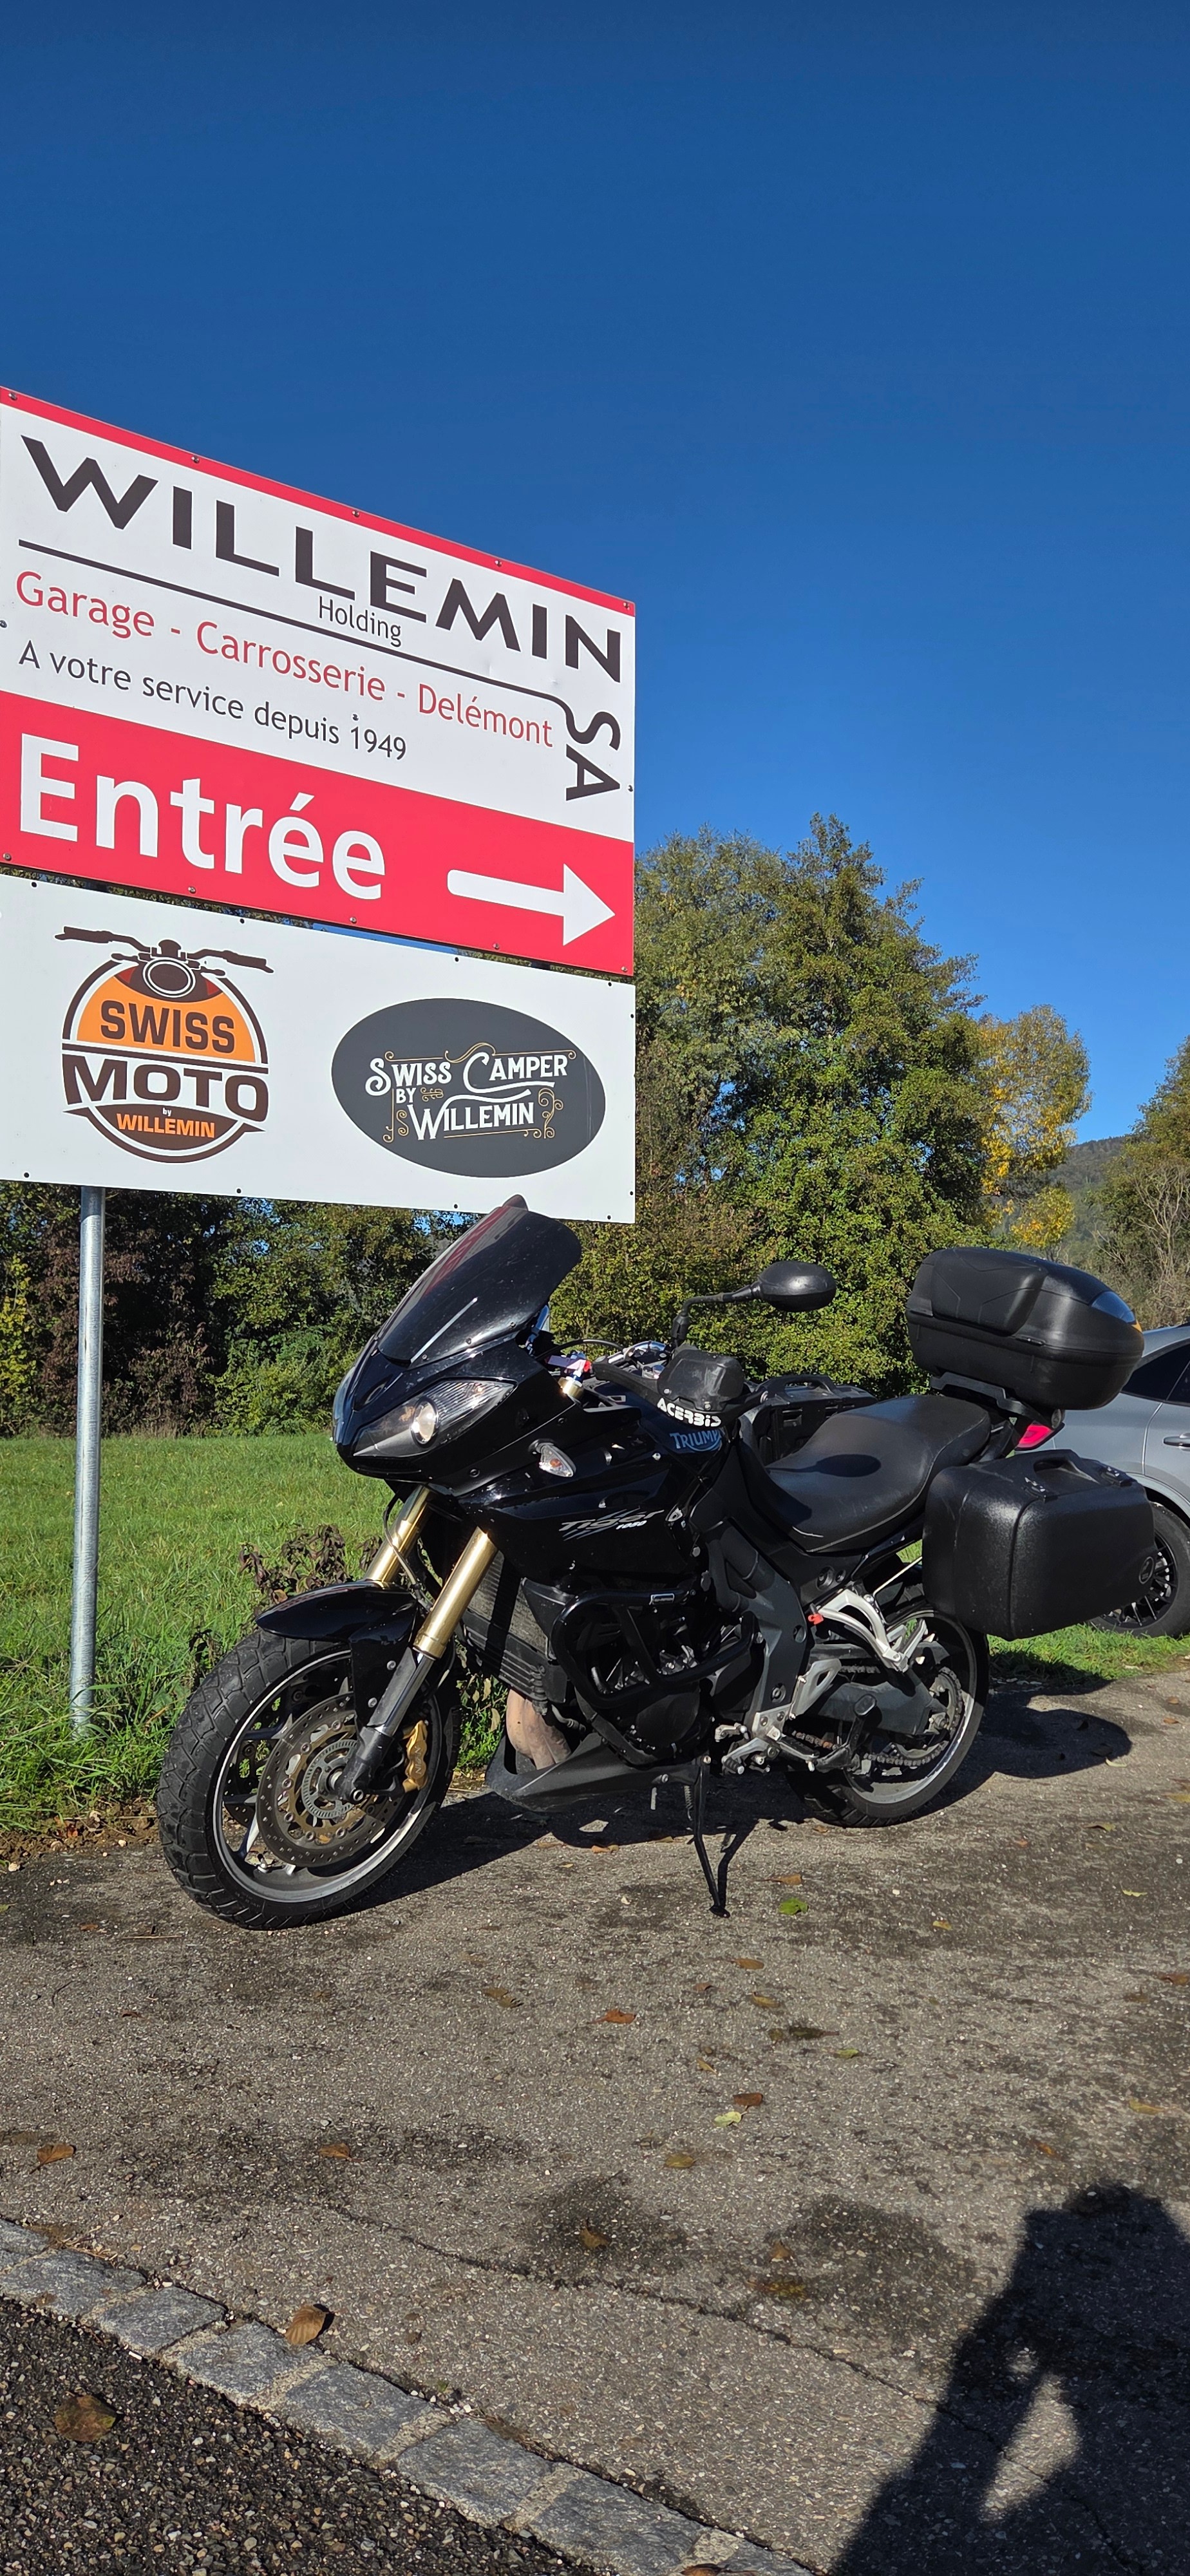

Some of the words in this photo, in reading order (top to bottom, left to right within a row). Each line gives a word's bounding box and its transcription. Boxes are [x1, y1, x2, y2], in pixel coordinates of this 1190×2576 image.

[21, 435, 620, 683] WILLEMIN
[319, 596, 401, 648] Holding
[17, 571, 154, 638] Garage
[197, 621, 385, 700] Carrosserie
[420, 684, 552, 747] Delémont
[19, 640, 40, 669] A
[50, 653, 131, 690] votre
[143, 677, 243, 719] service
[254, 701, 339, 744] depuis
[351, 726, 406, 760] 1949
[566, 707, 620, 800] SA
[20, 733, 385, 900] Entrée
[101, 1000, 234, 1054] SWISS
[62, 1054, 269, 1122] MOTO
[365, 1057, 452, 1096] SWISS
[396, 1088, 417, 1104] BY
[117, 1113, 215, 1138] WILLEMIN
[162, 1108, 172, 1116] by
[407, 1089, 534, 1141] WILLEMIN
[657, 1397, 722, 1427] ACERBIS
[616, 1520, 647, 1530] 1050
